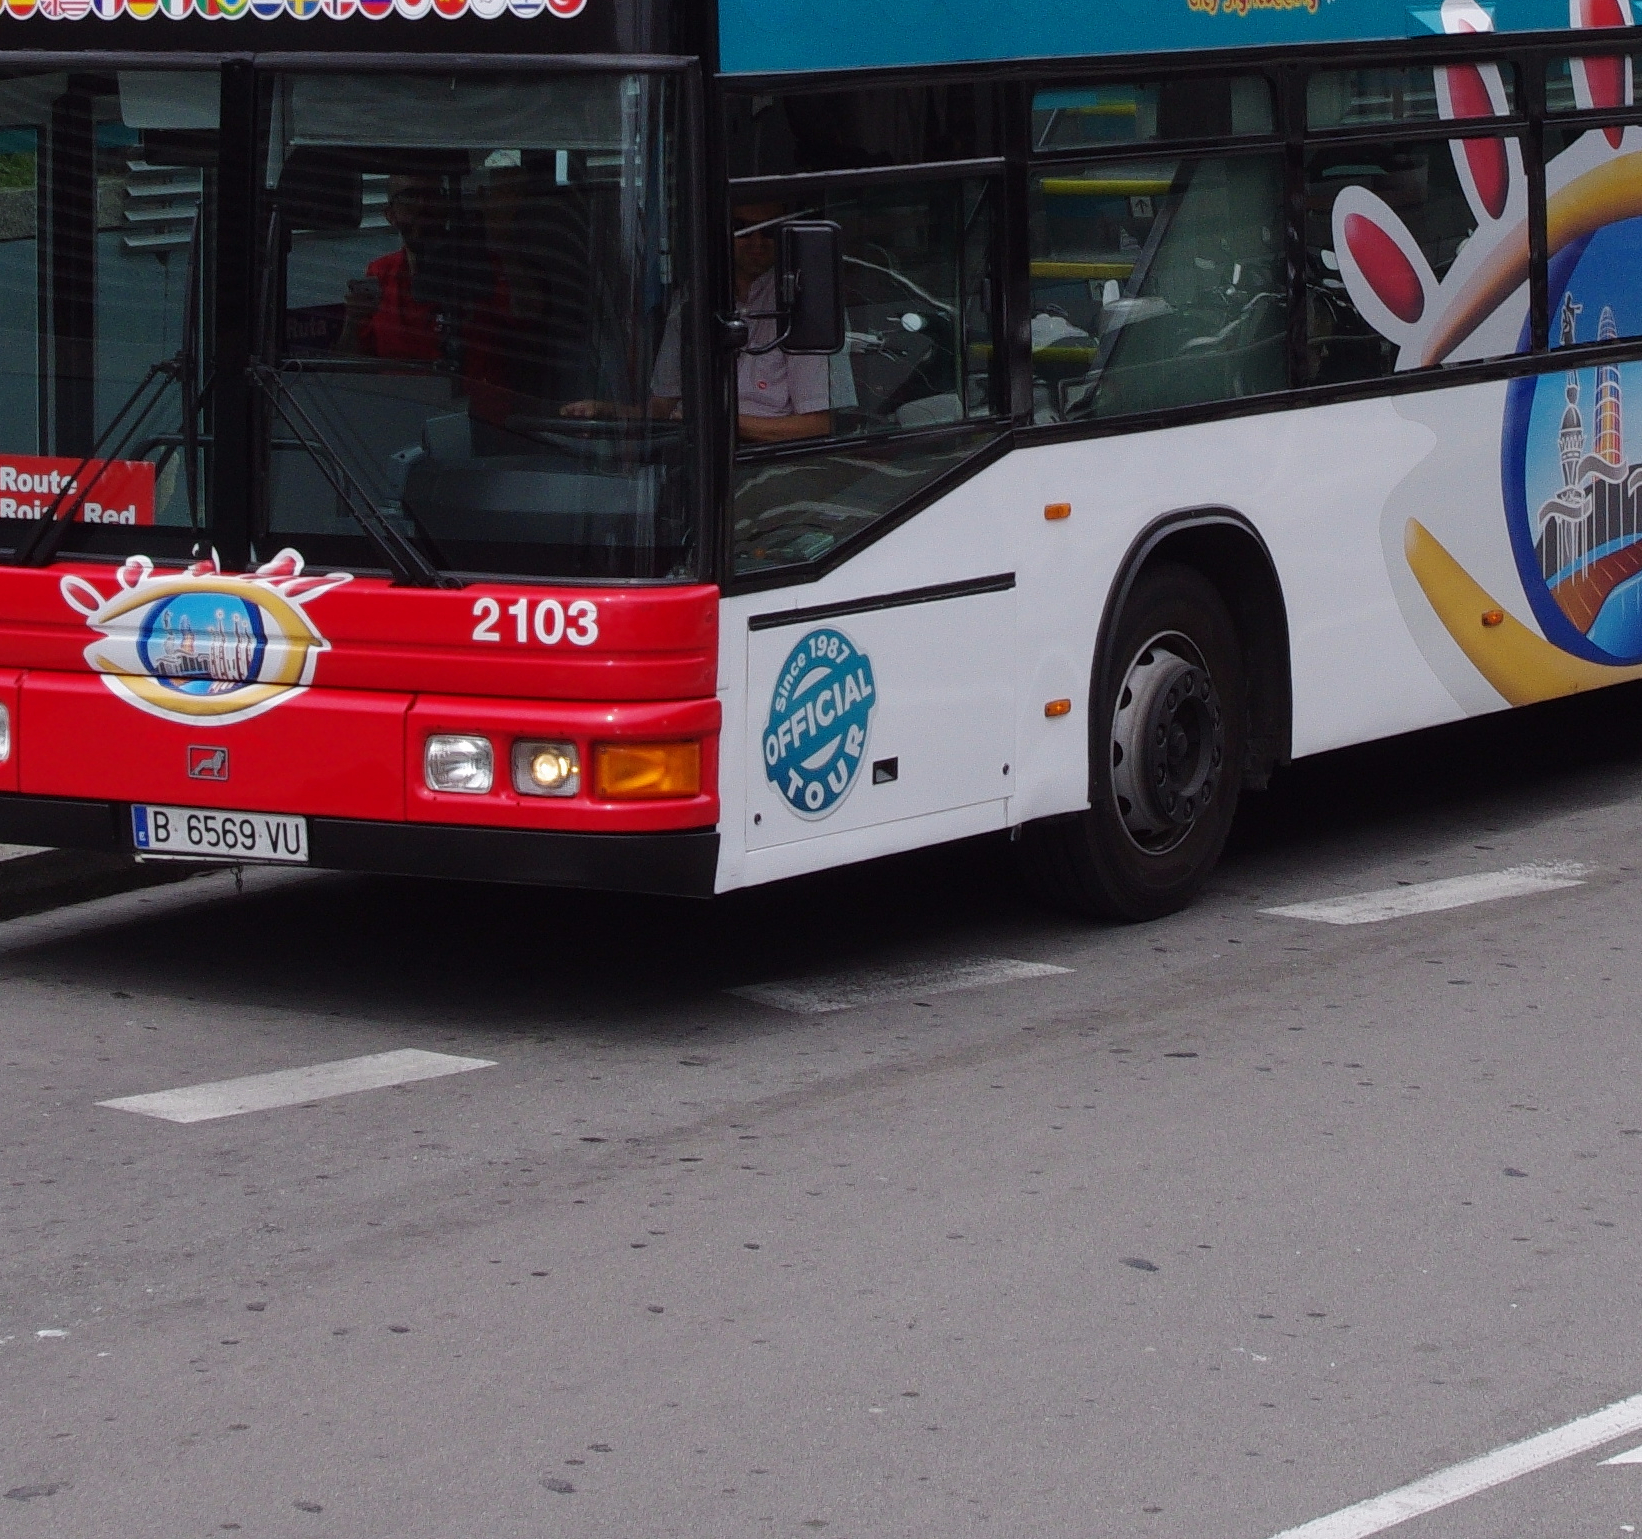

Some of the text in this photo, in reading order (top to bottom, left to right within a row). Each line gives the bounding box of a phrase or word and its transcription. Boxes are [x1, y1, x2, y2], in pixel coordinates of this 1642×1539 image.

[0, 466, 78, 495] Route
[83, 503, 136, 526] Red
[472, 597, 599, 647] 2103
[775, 634, 851, 713] Since 1987
[765, 668, 872, 766] OFFICIAL
[787, 723, 865, 810] TOUR
[153, 810, 301, 855] B 6569 VU
